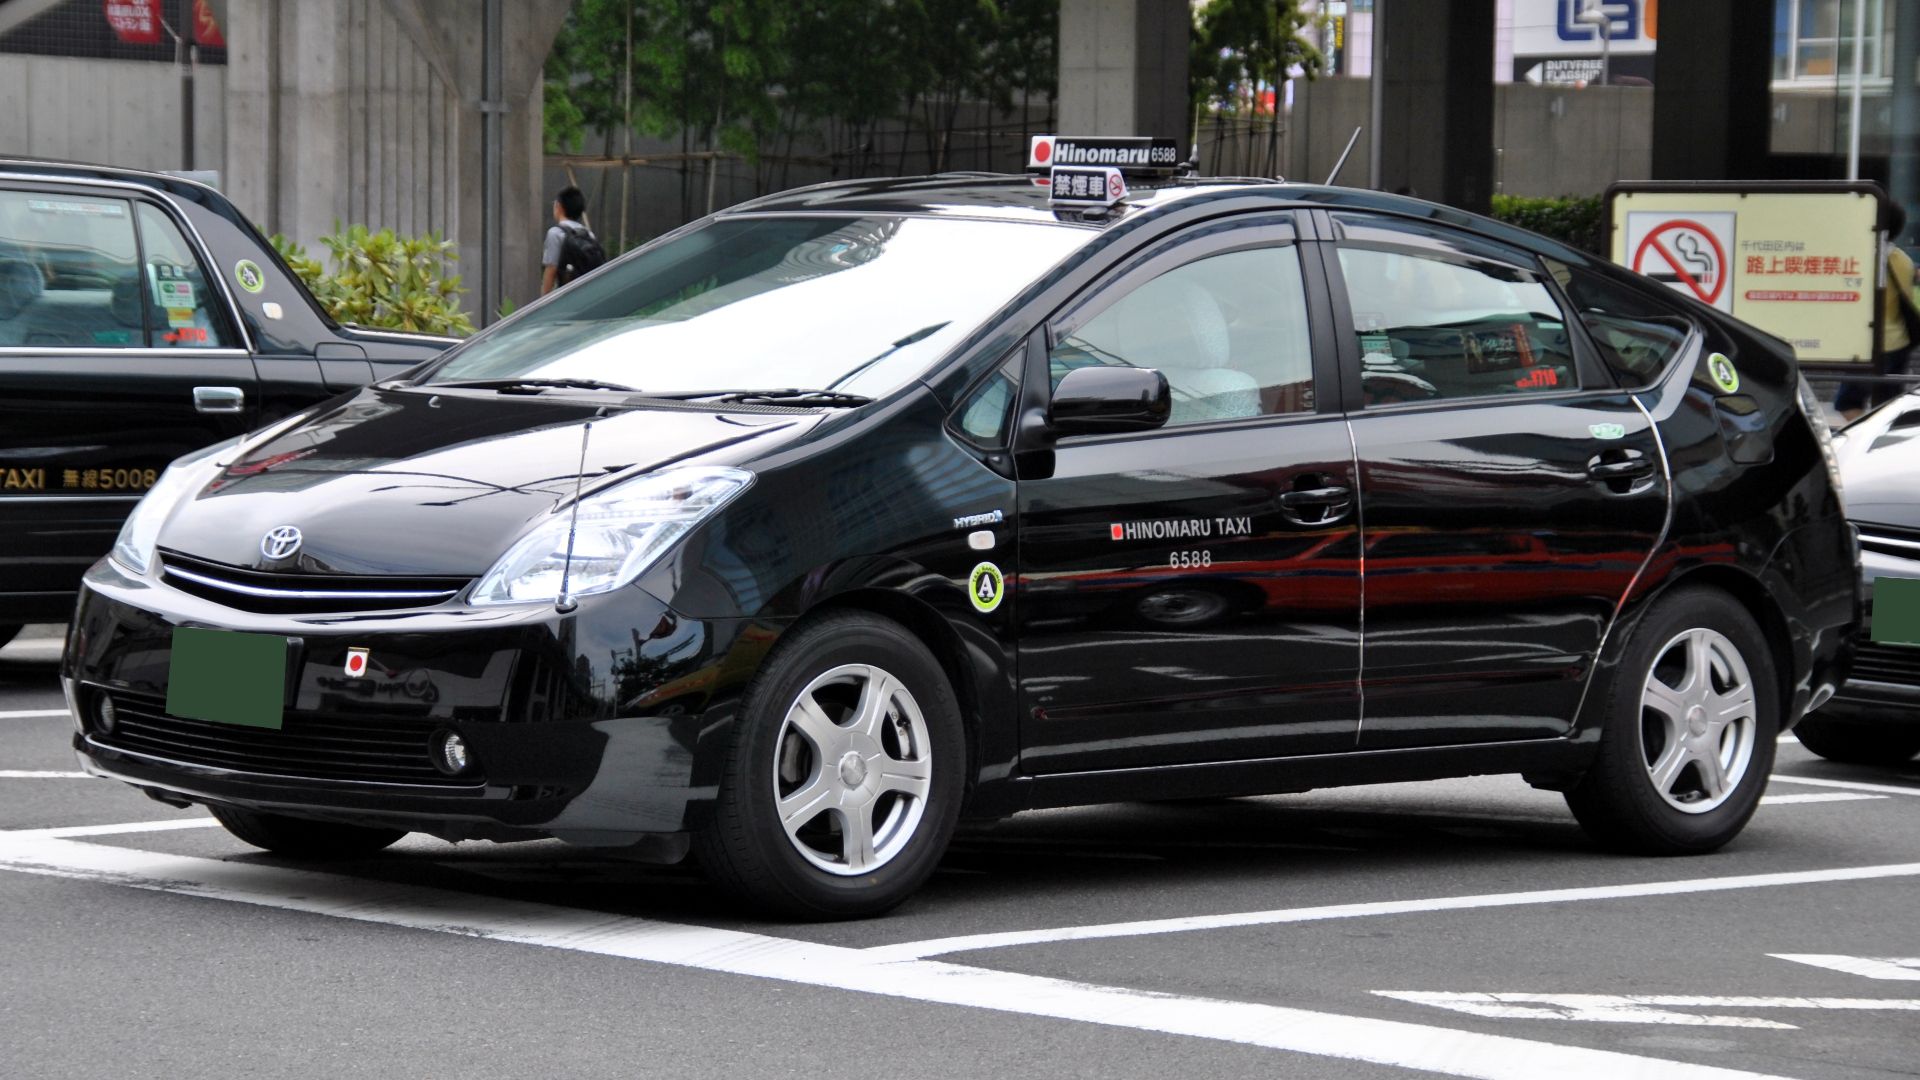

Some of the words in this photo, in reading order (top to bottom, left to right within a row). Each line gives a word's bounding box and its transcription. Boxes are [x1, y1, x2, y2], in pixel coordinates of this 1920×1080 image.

[1054, 143, 1149, 163] Hinomaru
[1151, 147, 1176, 162] 6588
[1054, 174, 1104, 197] 禁煙車
[1742, 240, 1805, 251] 千代田区内は
[1746, 255, 1861, 275] 路上喫煙禁止
[953, 511, 995, 528] HYBRID
[1126, 518, 1212, 540] HINOMARU
[1215, 516, 1252, 535] TAXI
[1169, 550, 1212, 569] 6588
[978, 573, 995, 598] A
